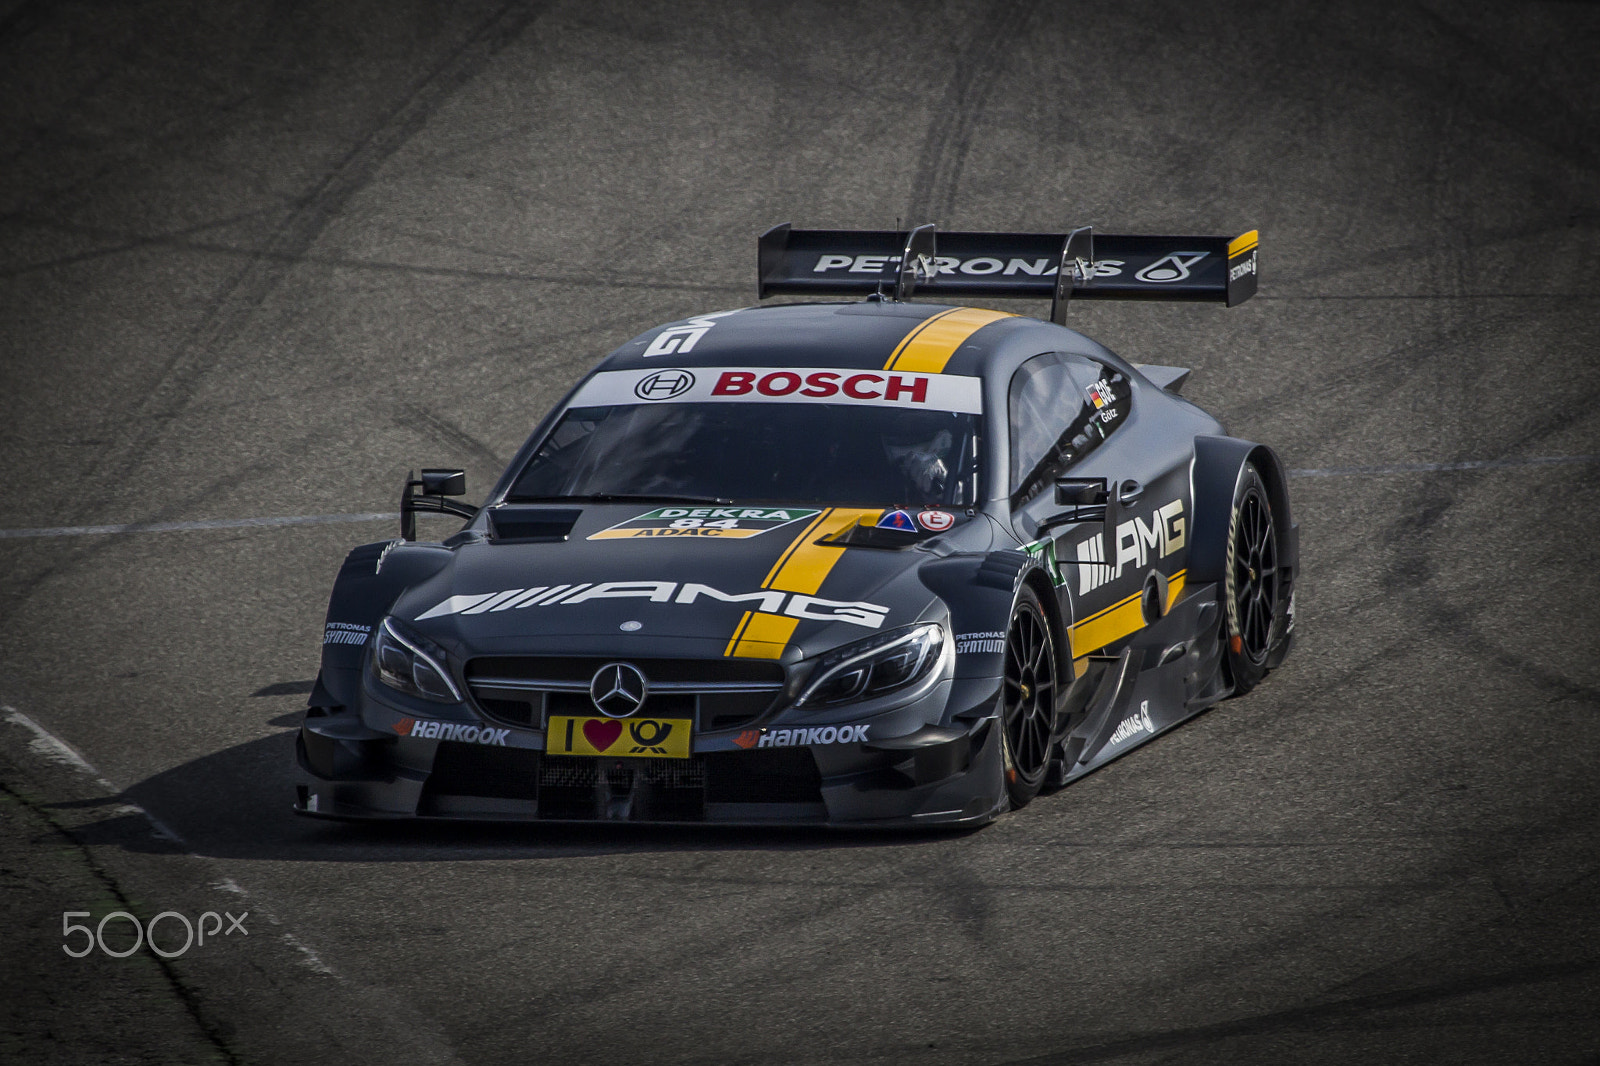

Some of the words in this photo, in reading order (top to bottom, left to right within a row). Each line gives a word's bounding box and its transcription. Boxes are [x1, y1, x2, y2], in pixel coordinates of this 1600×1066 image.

[711, 371, 928, 403] BOSCH
[658, 509, 791, 520] DEKRA
[669, 518, 739, 529] 84
[632, 529, 724, 537] ADAC
[1115, 499, 1185, 579] AMG
[560, 581, 890, 629] AMG
[326, 622, 371, 631] PETRONAS
[956, 632, 1005, 640] PETRONAS
[565, 719, 574, 752] I
